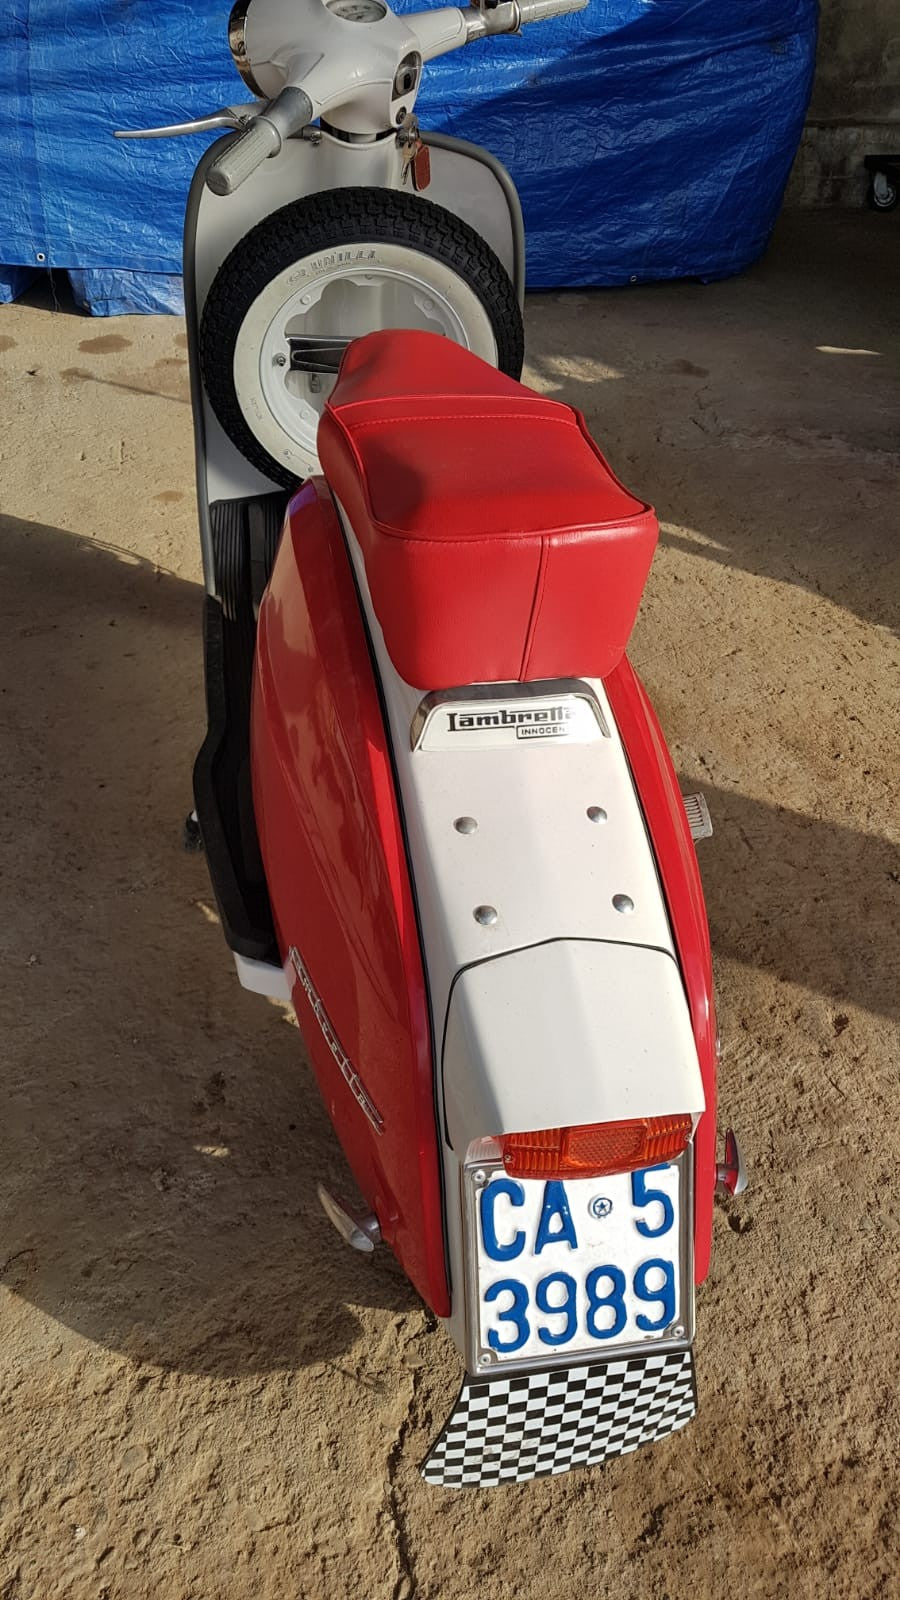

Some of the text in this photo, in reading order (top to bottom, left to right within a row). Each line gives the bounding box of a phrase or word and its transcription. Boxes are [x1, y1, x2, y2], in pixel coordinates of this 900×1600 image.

[479, 1163, 674, 1262] CA 5
[484, 1258, 676, 1353] 3989
